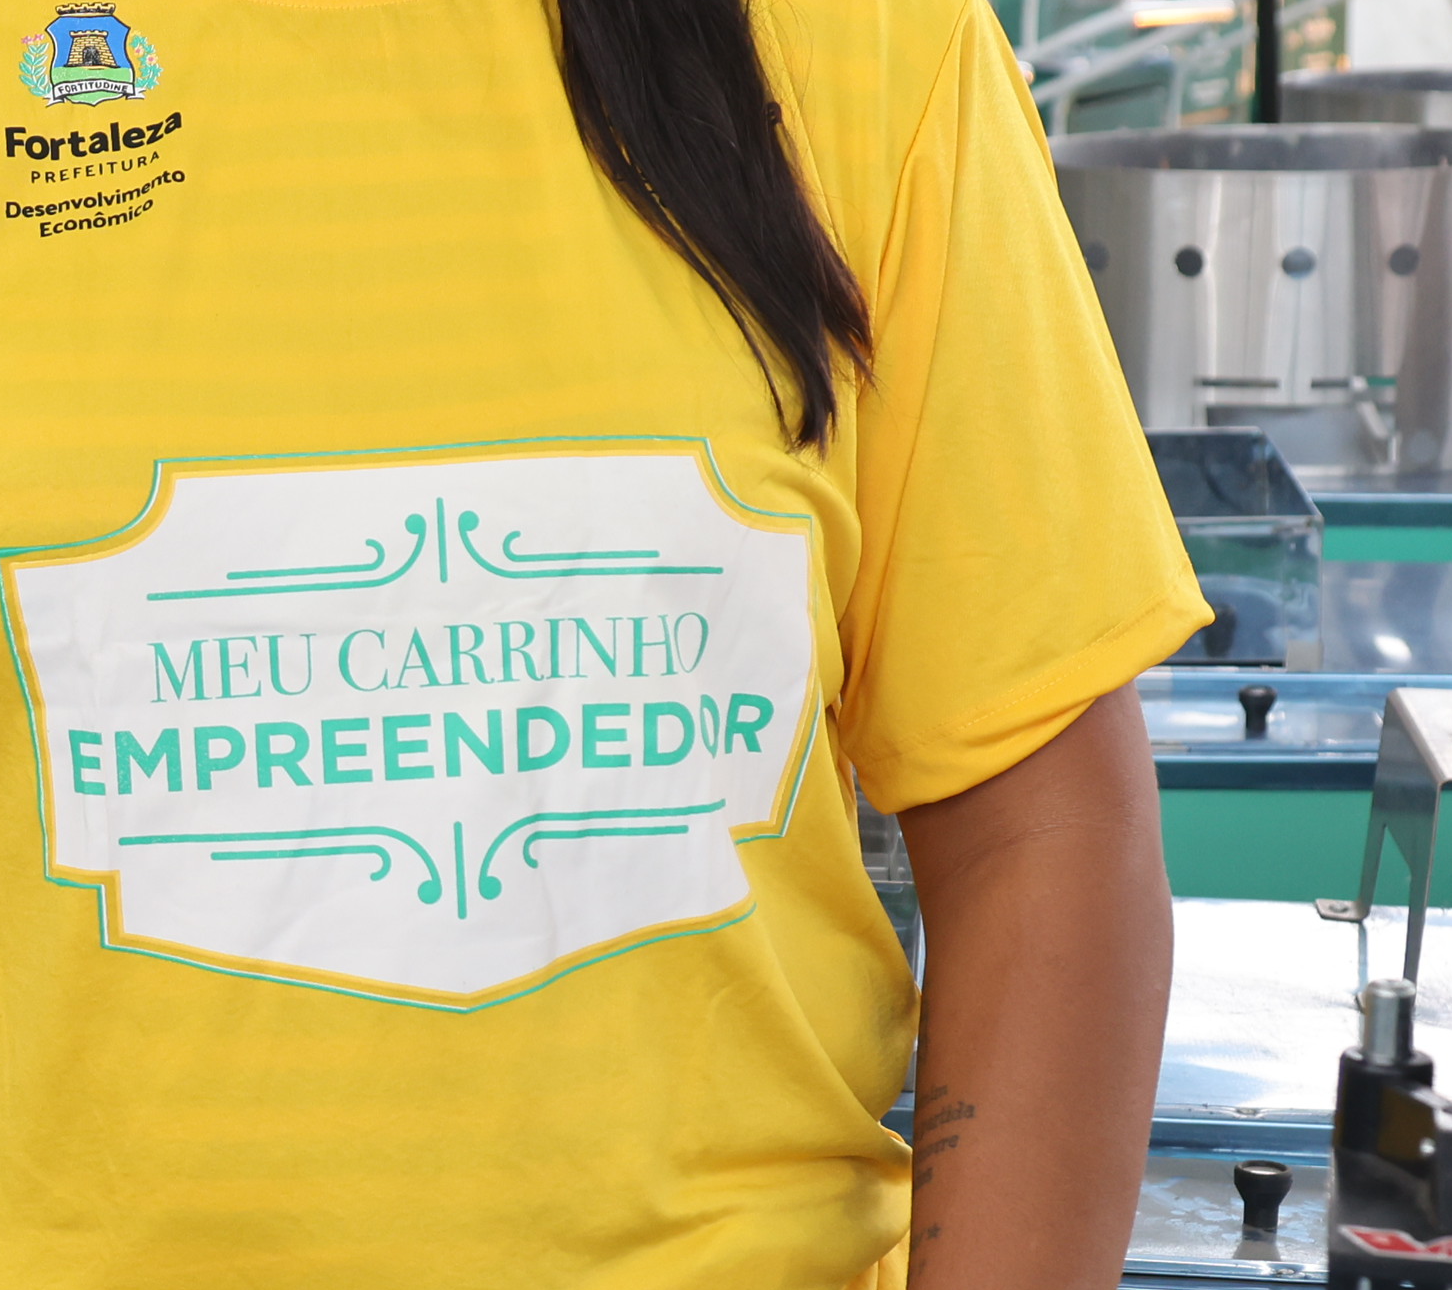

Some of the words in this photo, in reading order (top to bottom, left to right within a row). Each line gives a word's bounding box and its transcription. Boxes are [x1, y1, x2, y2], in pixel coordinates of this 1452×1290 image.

[57, 81, 129, 95] FORTITUDINE
[5, 111, 182, 160] Fortaleza
[31, 151, 160, 184] PREFEITURA
[5, 170, 185, 219] Desenvolvimento
[40, 198, 153, 237] Econômico
[148, 631, 317, 704] MEU
[338, 612, 709, 693] CARRINHO
[69, 692, 774, 796] EMPREENDEDOR
